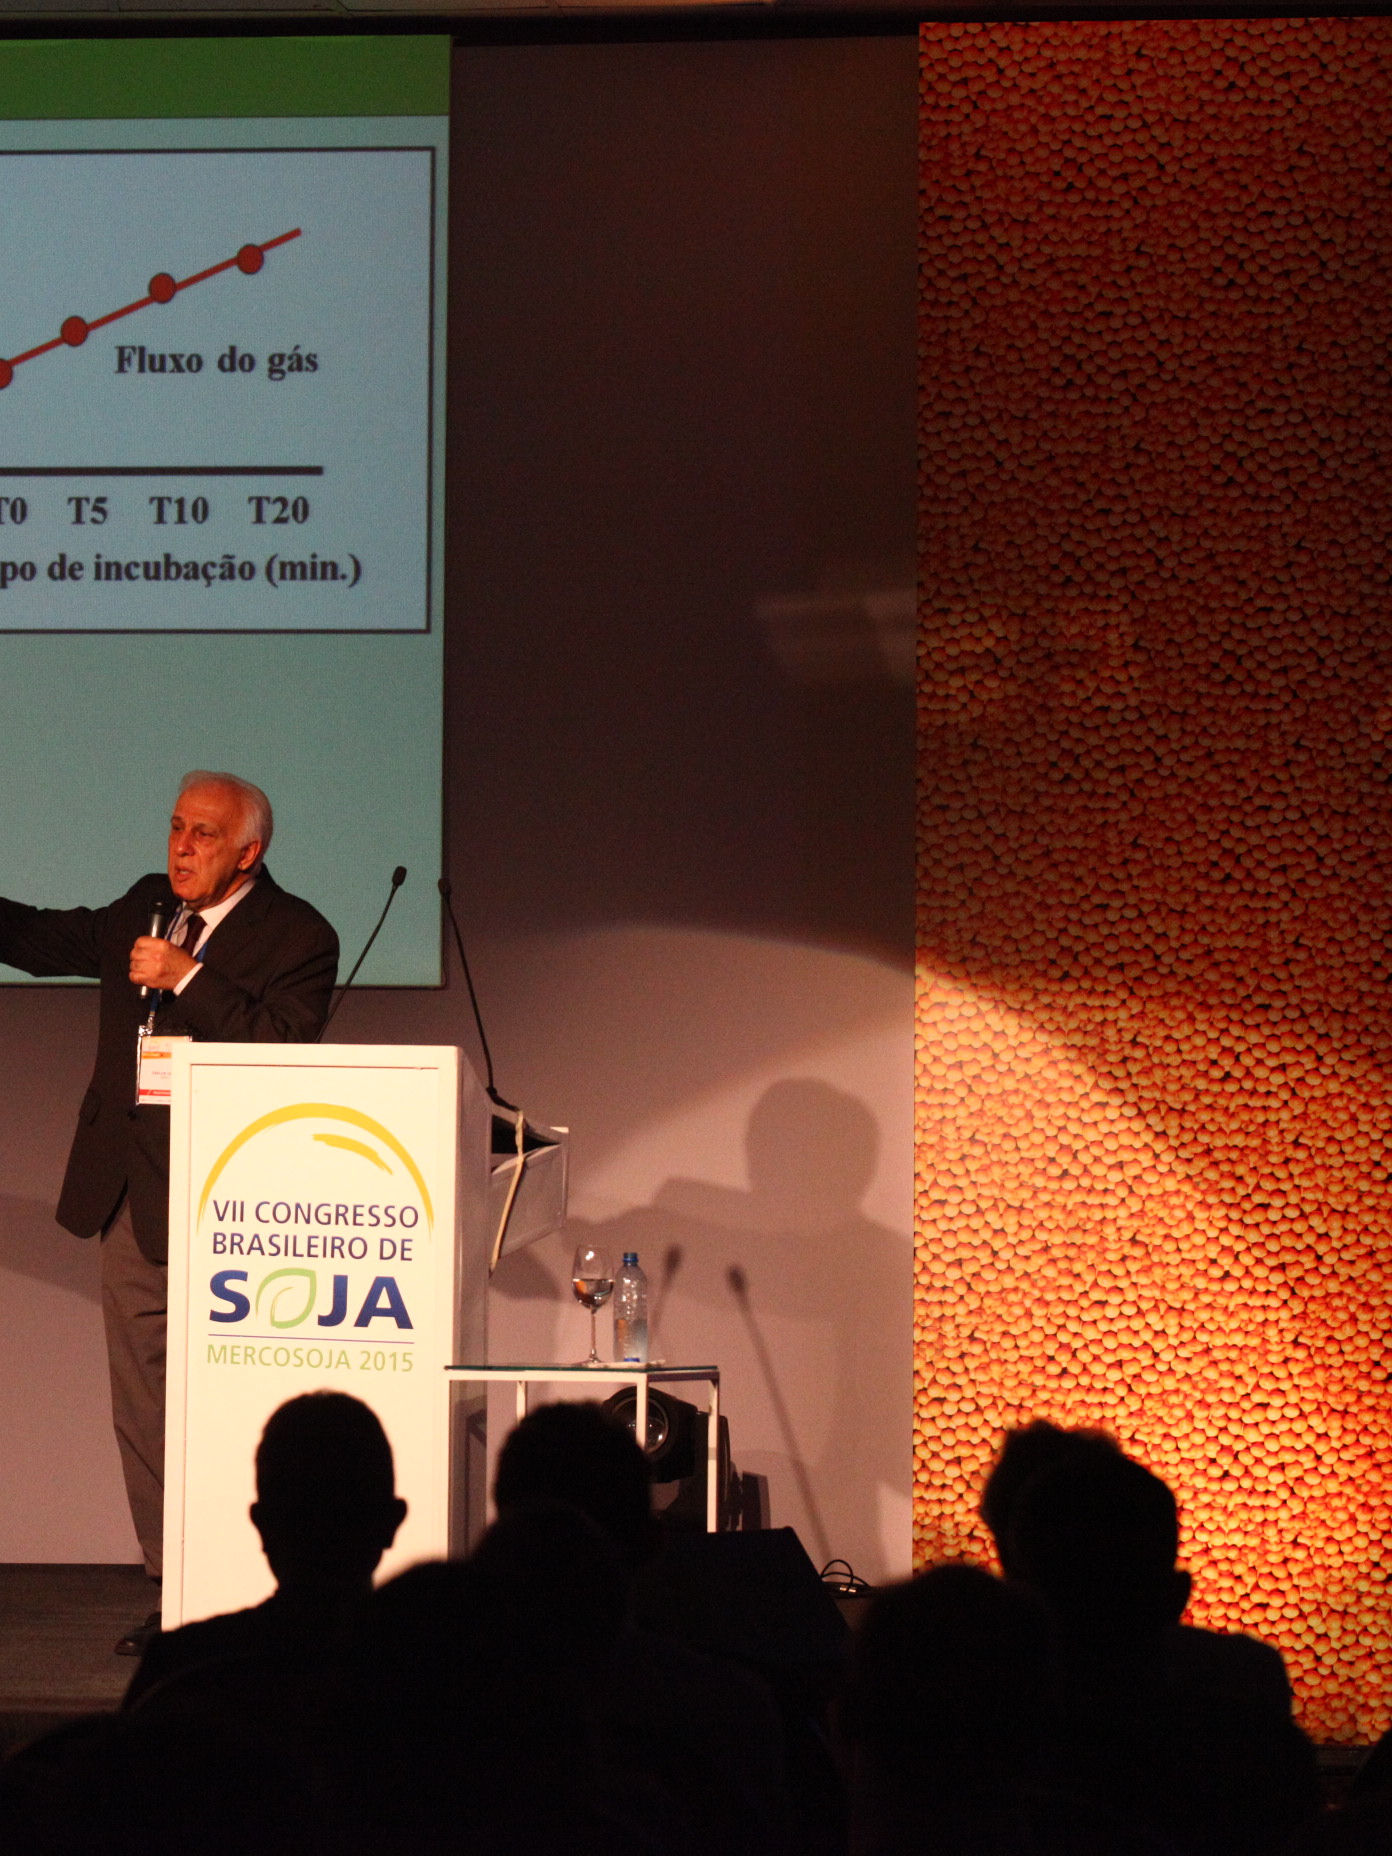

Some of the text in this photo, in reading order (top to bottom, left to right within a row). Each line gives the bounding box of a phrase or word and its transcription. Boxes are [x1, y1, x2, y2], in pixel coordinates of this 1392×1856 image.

[115, 344, 319, 381] Fluxo do gás
[67, 496, 108, 525] T5
[149, 496, 209, 525] T10
[247, 495, 310, 524] T20
[47, 552, 84, 581] de
[93, 552, 256, 588] incubação
[264, 552, 362, 588] (min.)
[213, 1200, 419, 1229] VII CONGRESSO
[212, 1232, 414, 1262] BRASILEIRO DE
[209, 1267, 414, 1330] SOJA
[207, 1344, 414, 1373] MERCOSOJA 2015
